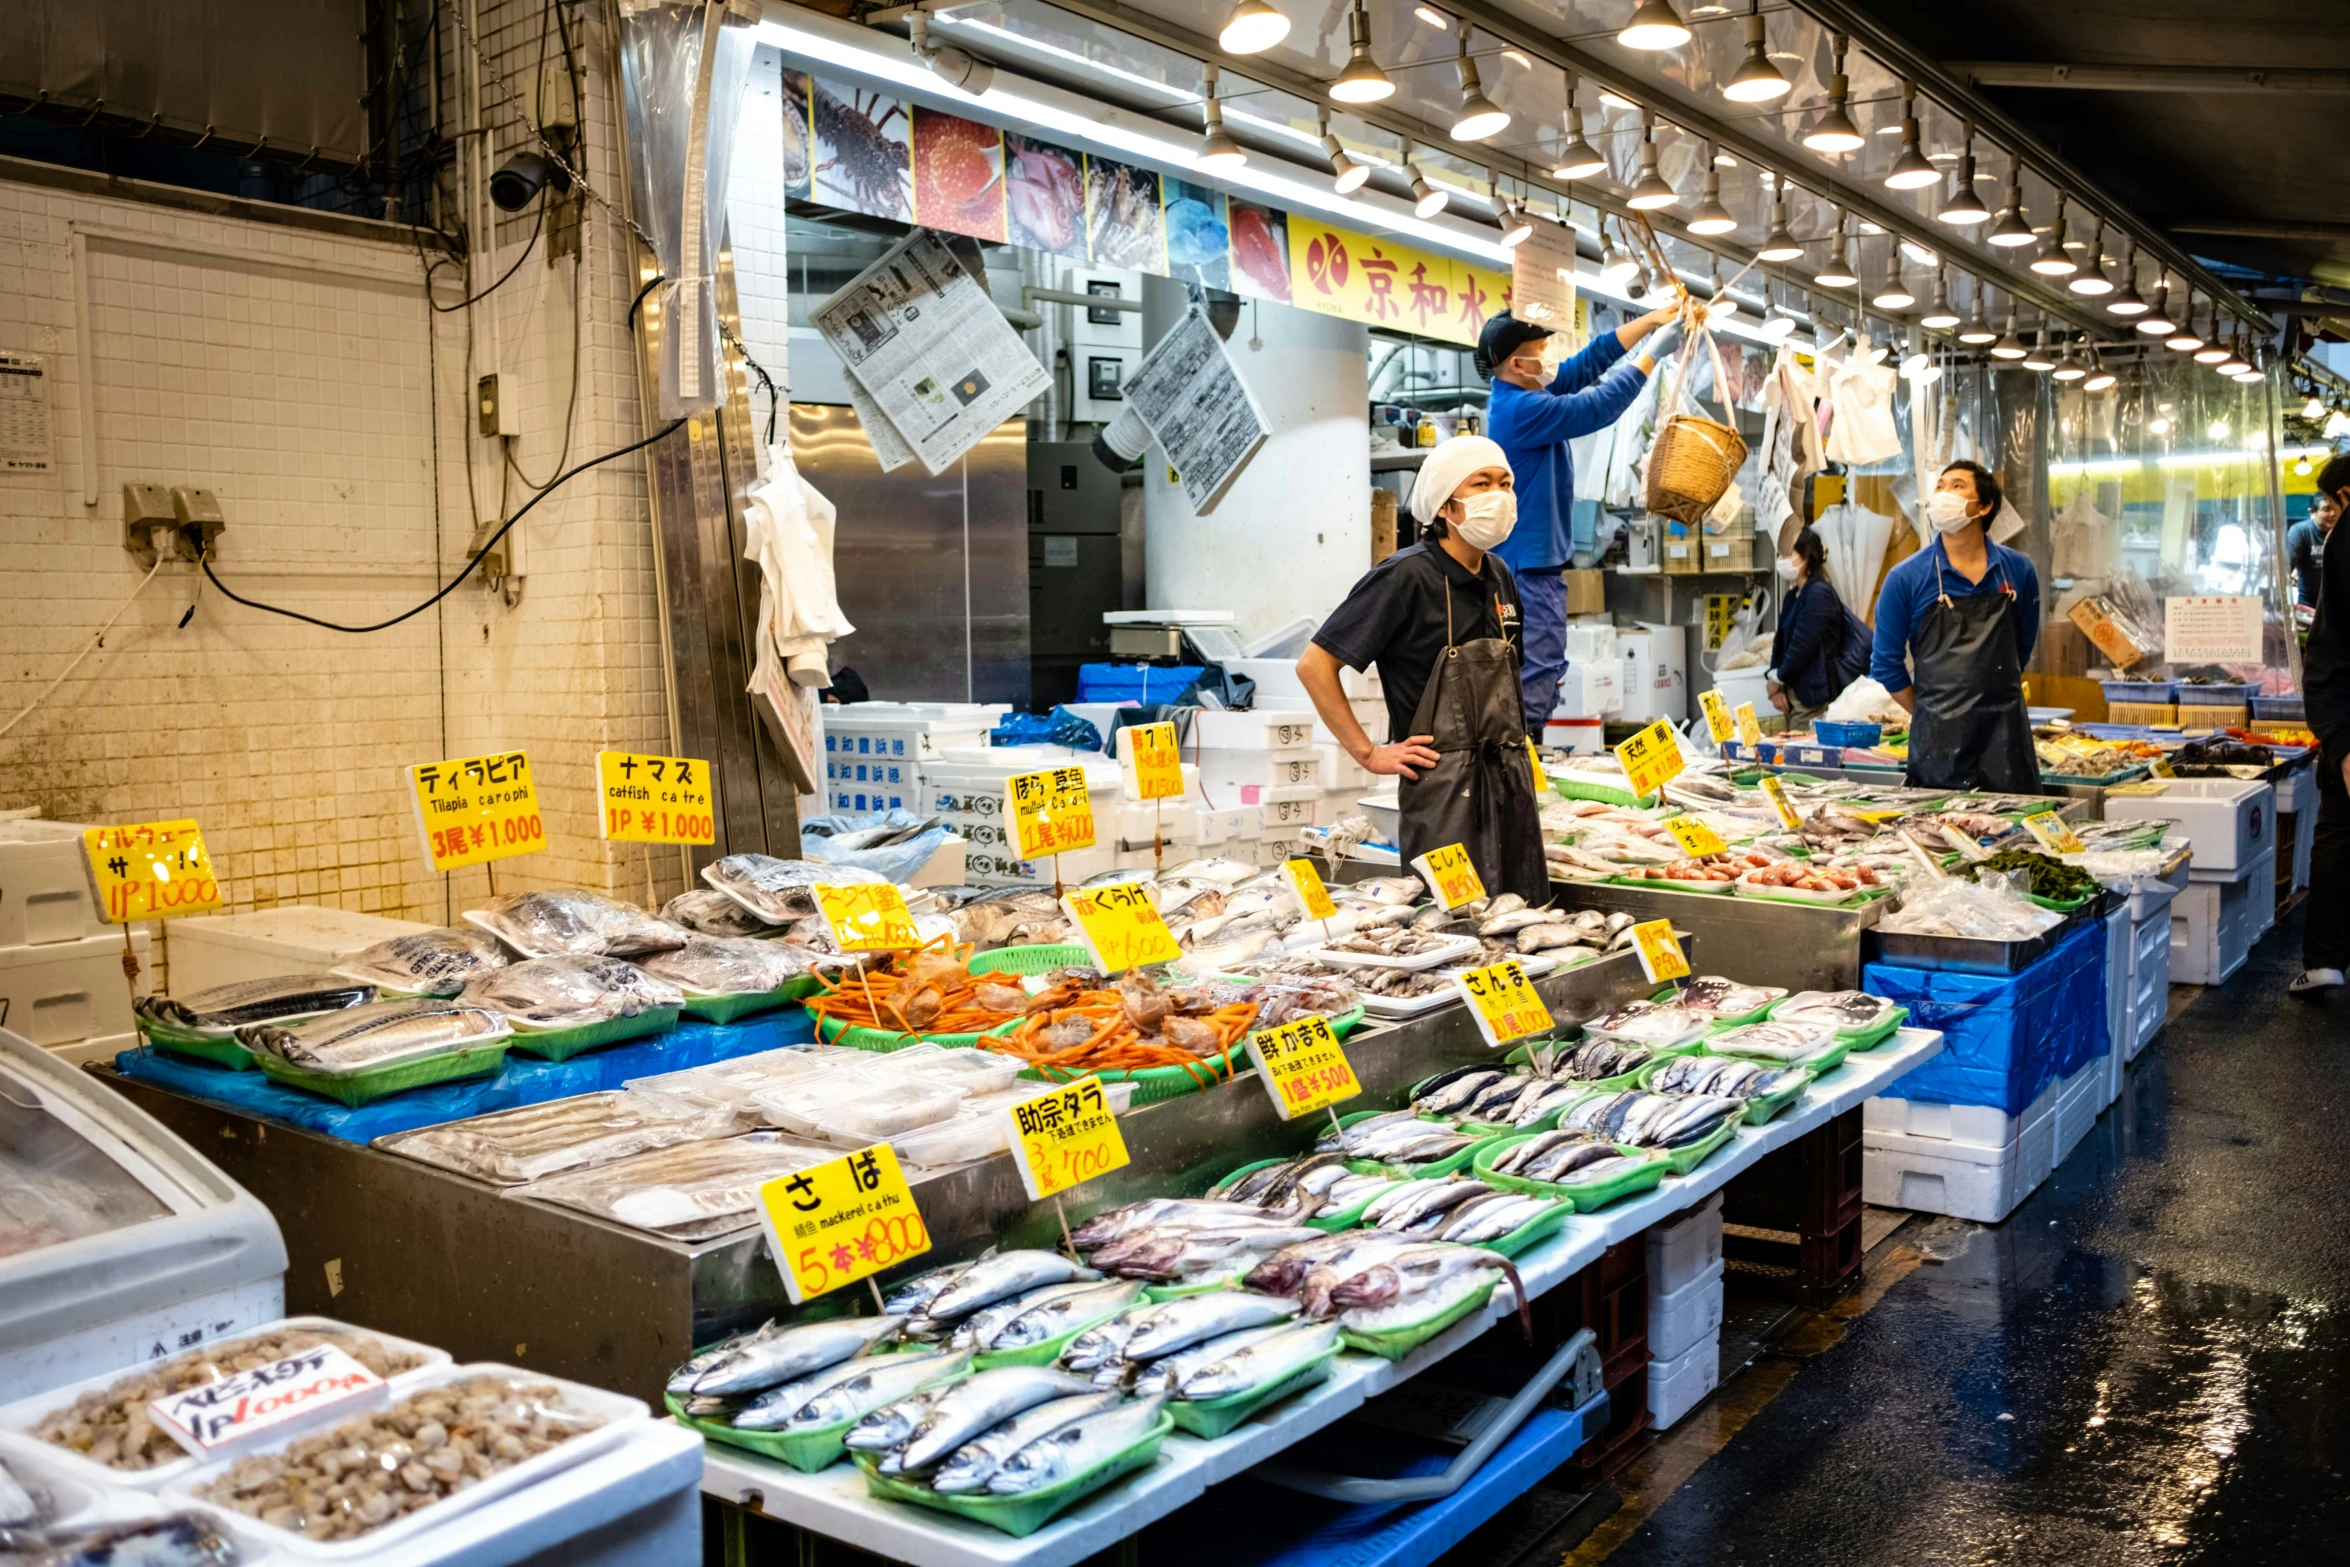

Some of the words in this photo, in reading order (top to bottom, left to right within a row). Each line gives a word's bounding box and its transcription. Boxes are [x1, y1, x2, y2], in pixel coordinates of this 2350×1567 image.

[1317, 301, 1343, 314] KYOWA
[1359, 247, 1513, 342] 京和水
[420, 754, 525, 793] ティラピア
[620, 757, 693, 785] ナマズ
[430, 796, 468, 814] Tilapia
[609, 785, 650, 801] catfish
[432, 814, 542, 858] 3尾¥1,000
[641, 811, 713, 840] ¥1,000
[1427, 847, 1467, 873] にしん
[1125, 932, 1166, 963] 600
[1466, 964, 1524, 996] さんま
[1016, 1083, 1101, 1136] 助宗タラ
[785, 1149, 881, 1212] さば
[820, 1203, 866, 1229] mackerel
